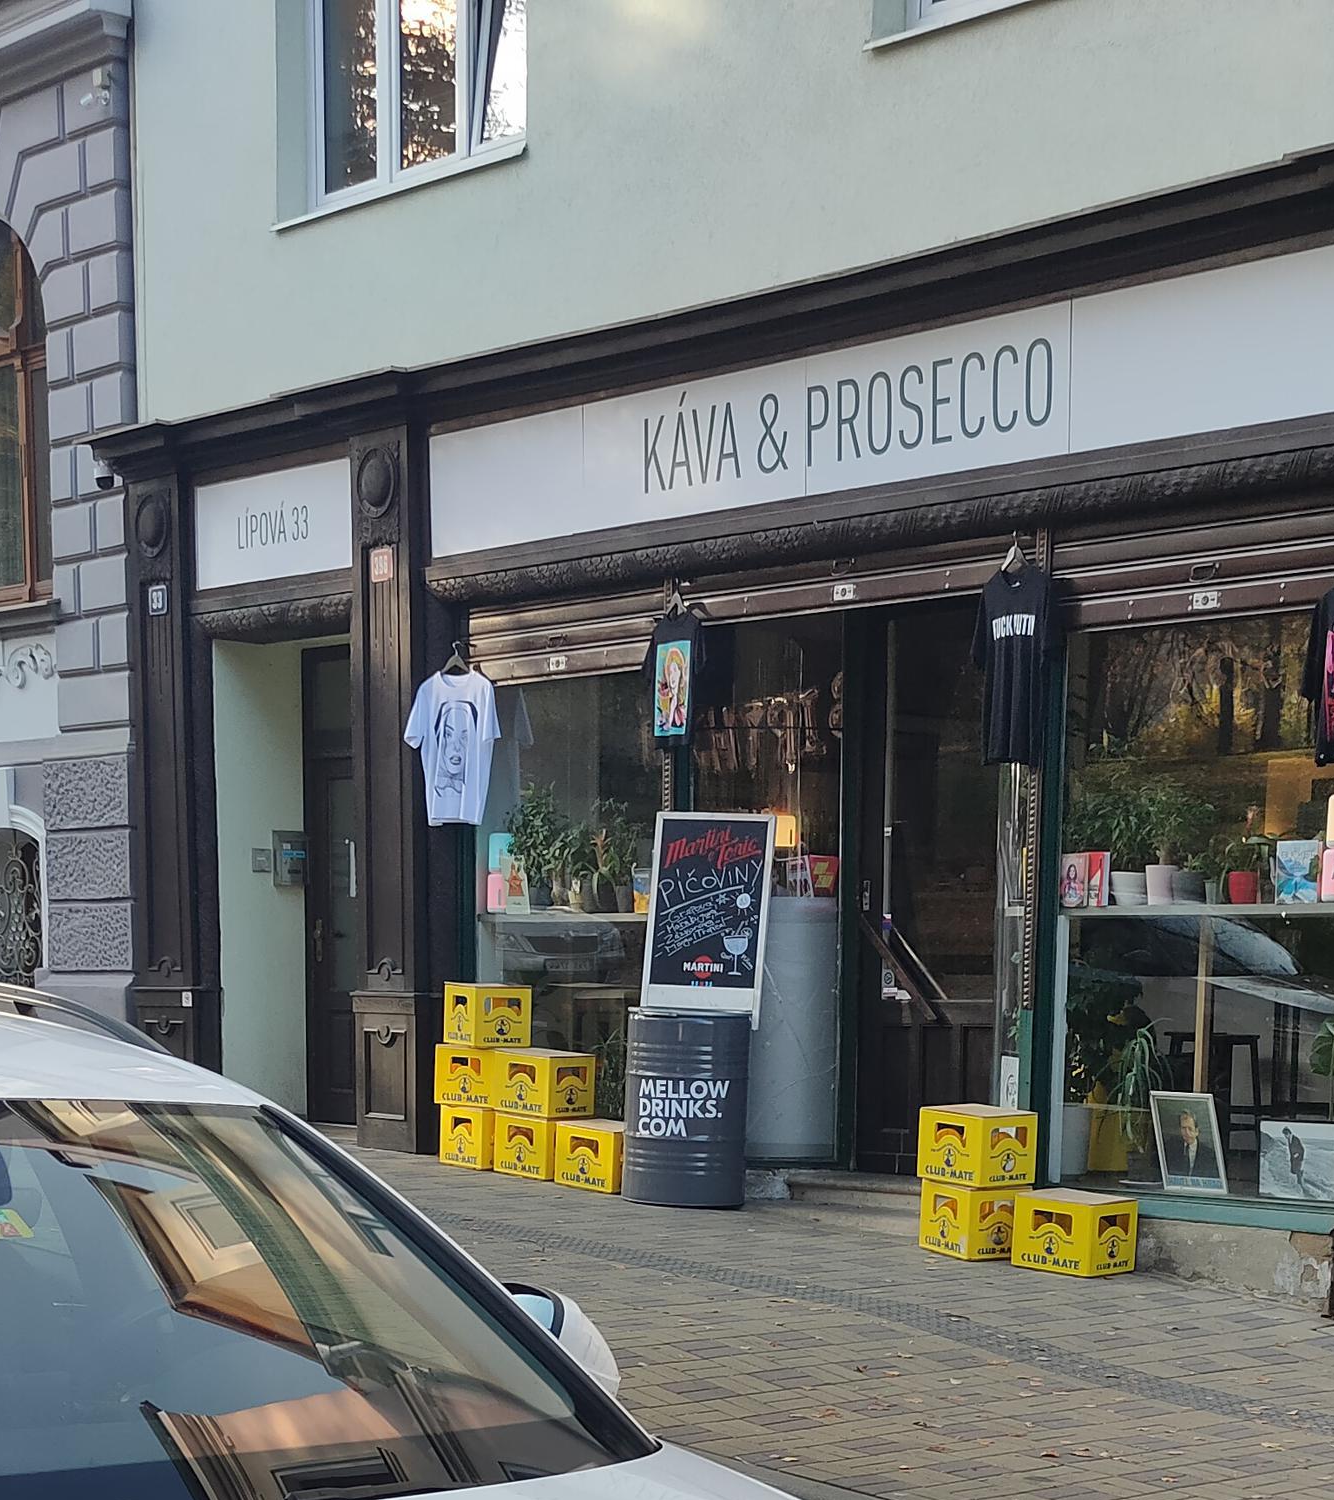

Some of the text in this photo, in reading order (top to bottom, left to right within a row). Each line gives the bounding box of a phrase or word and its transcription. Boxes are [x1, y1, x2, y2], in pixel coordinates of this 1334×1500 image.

[643, 338, 1053, 494] KÁVA & PROSECCO
[237, 501, 309, 549] LÍPOVÁ 33
[152, 591, 163, 609] 33
[683, 961, 724, 973] MARTINI
[638, 1079, 730, 1099] MELLOW
[442, 1092, 488, 1104] CLUB-MATE
[500, 1099, 542, 1113] CLUB-MATE
[638, 1098, 723, 1119] DRINKS.
[637, 1118, 687, 1137] COM
[444, 1152, 477, 1165] CLUB-MATE
[500, 1160, 540, 1175] CLUB-MATE
[925, 1165, 974, 1181] CLUB-MATE
[561, 1171, 606, 1188] CLUB-MATE
[989, 1173, 1027, 1183] CLUB-MATE
[977, 1247, 1011, 1255] CLUB-MA
[1021, 1253, 1080, 1270] CLUB-MATE
